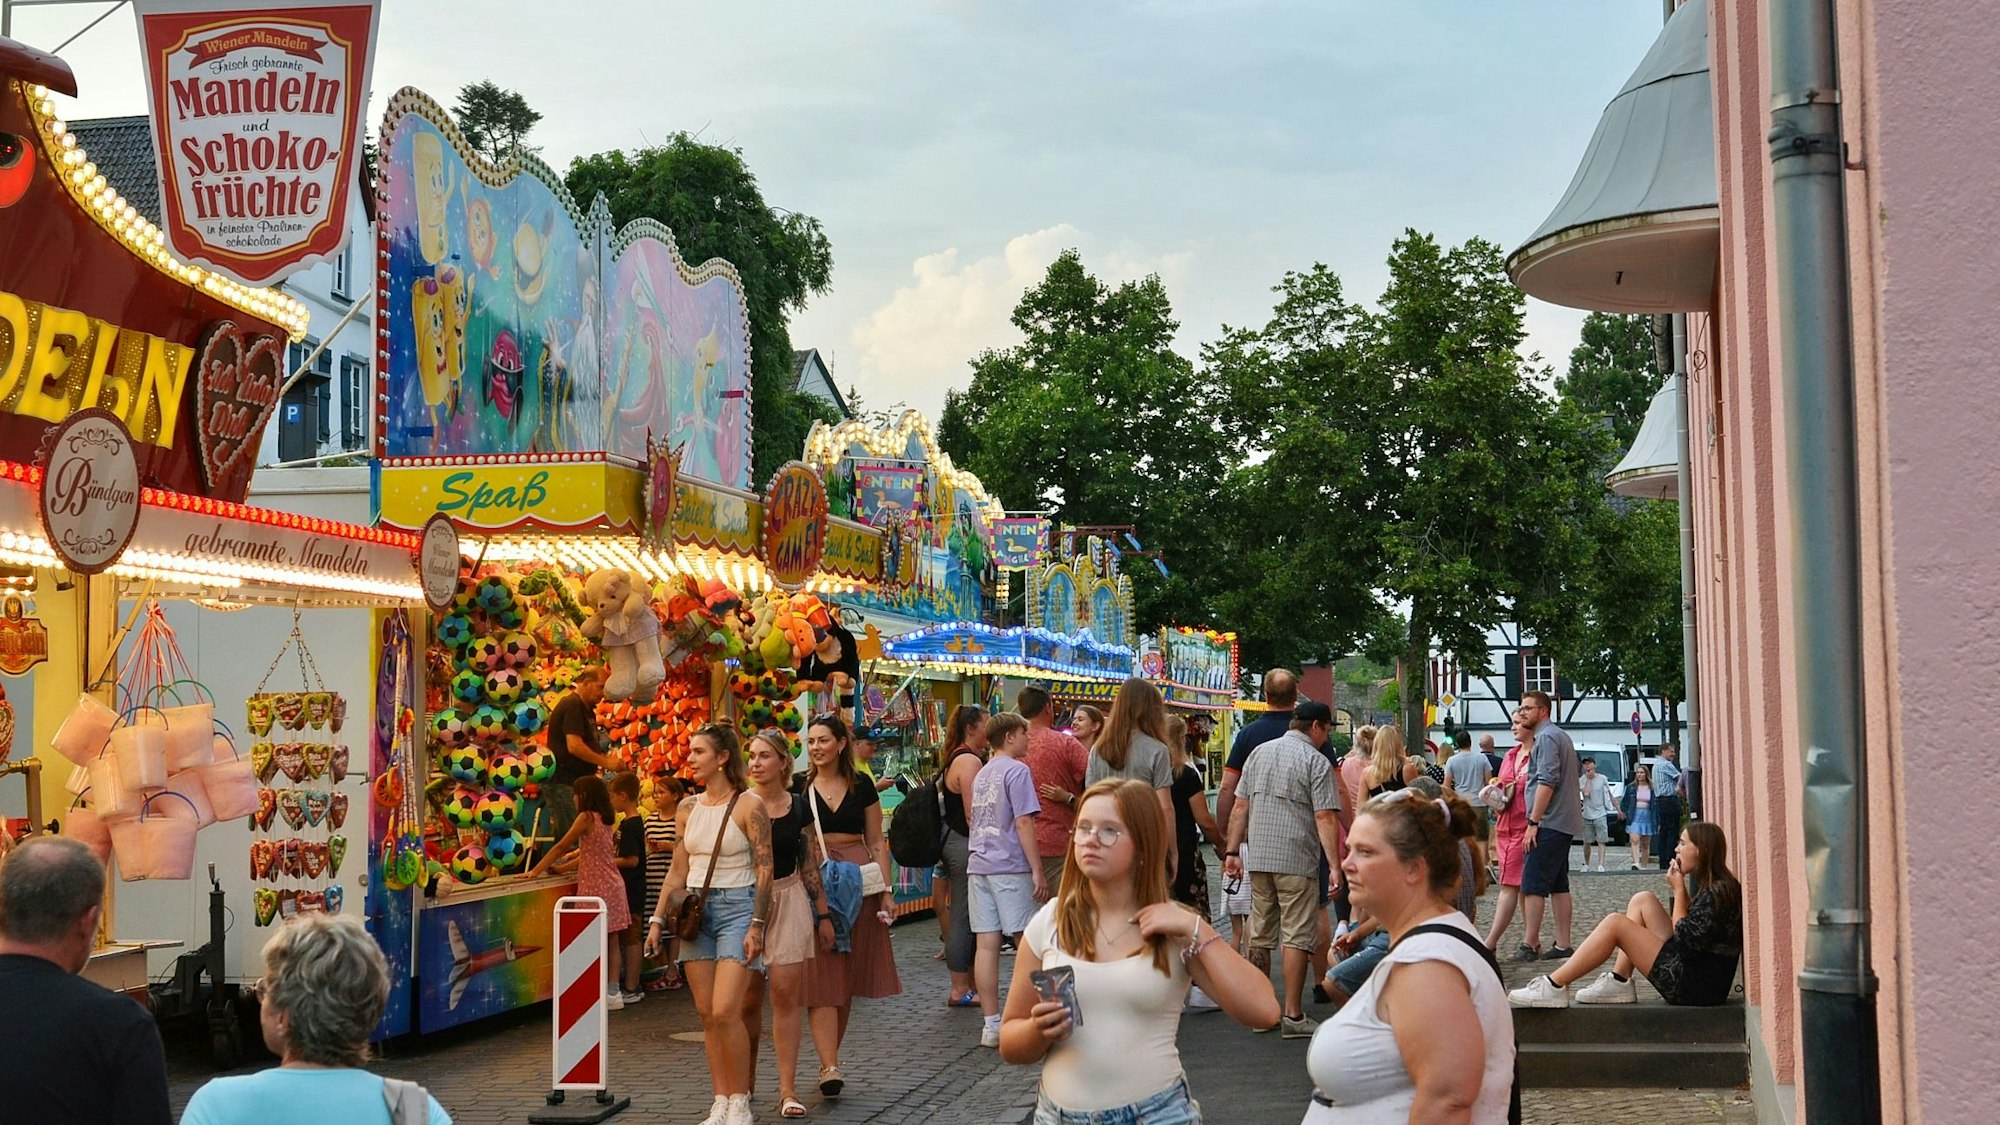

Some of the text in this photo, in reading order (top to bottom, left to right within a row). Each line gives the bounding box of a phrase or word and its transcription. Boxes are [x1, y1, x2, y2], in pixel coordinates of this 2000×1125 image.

[204, 30, 308, 54] Wiener Mandeln
[209, 55, 304, 75] Frisch gebrannte
[169, 71, 341, 120] Mandeln
[242, 118, 270, 132] und
[180, 130, 340, 178] Schoko-
[191, 175, 321, 219] früchte
[206, 220, 306, 237] in feinster Pralinen-
[225, 234, 282, 248] schokolade
[287, 405, 299, 421] P
[51, 456, 135, 517] Bündgen
[436, 470, 549, 520] Spaß
[863, 474, 914, 490] ENTEN
[771, 474, 818, 533] CRAZY
[178, 523, 370, 576] gebrannte Mandeln
